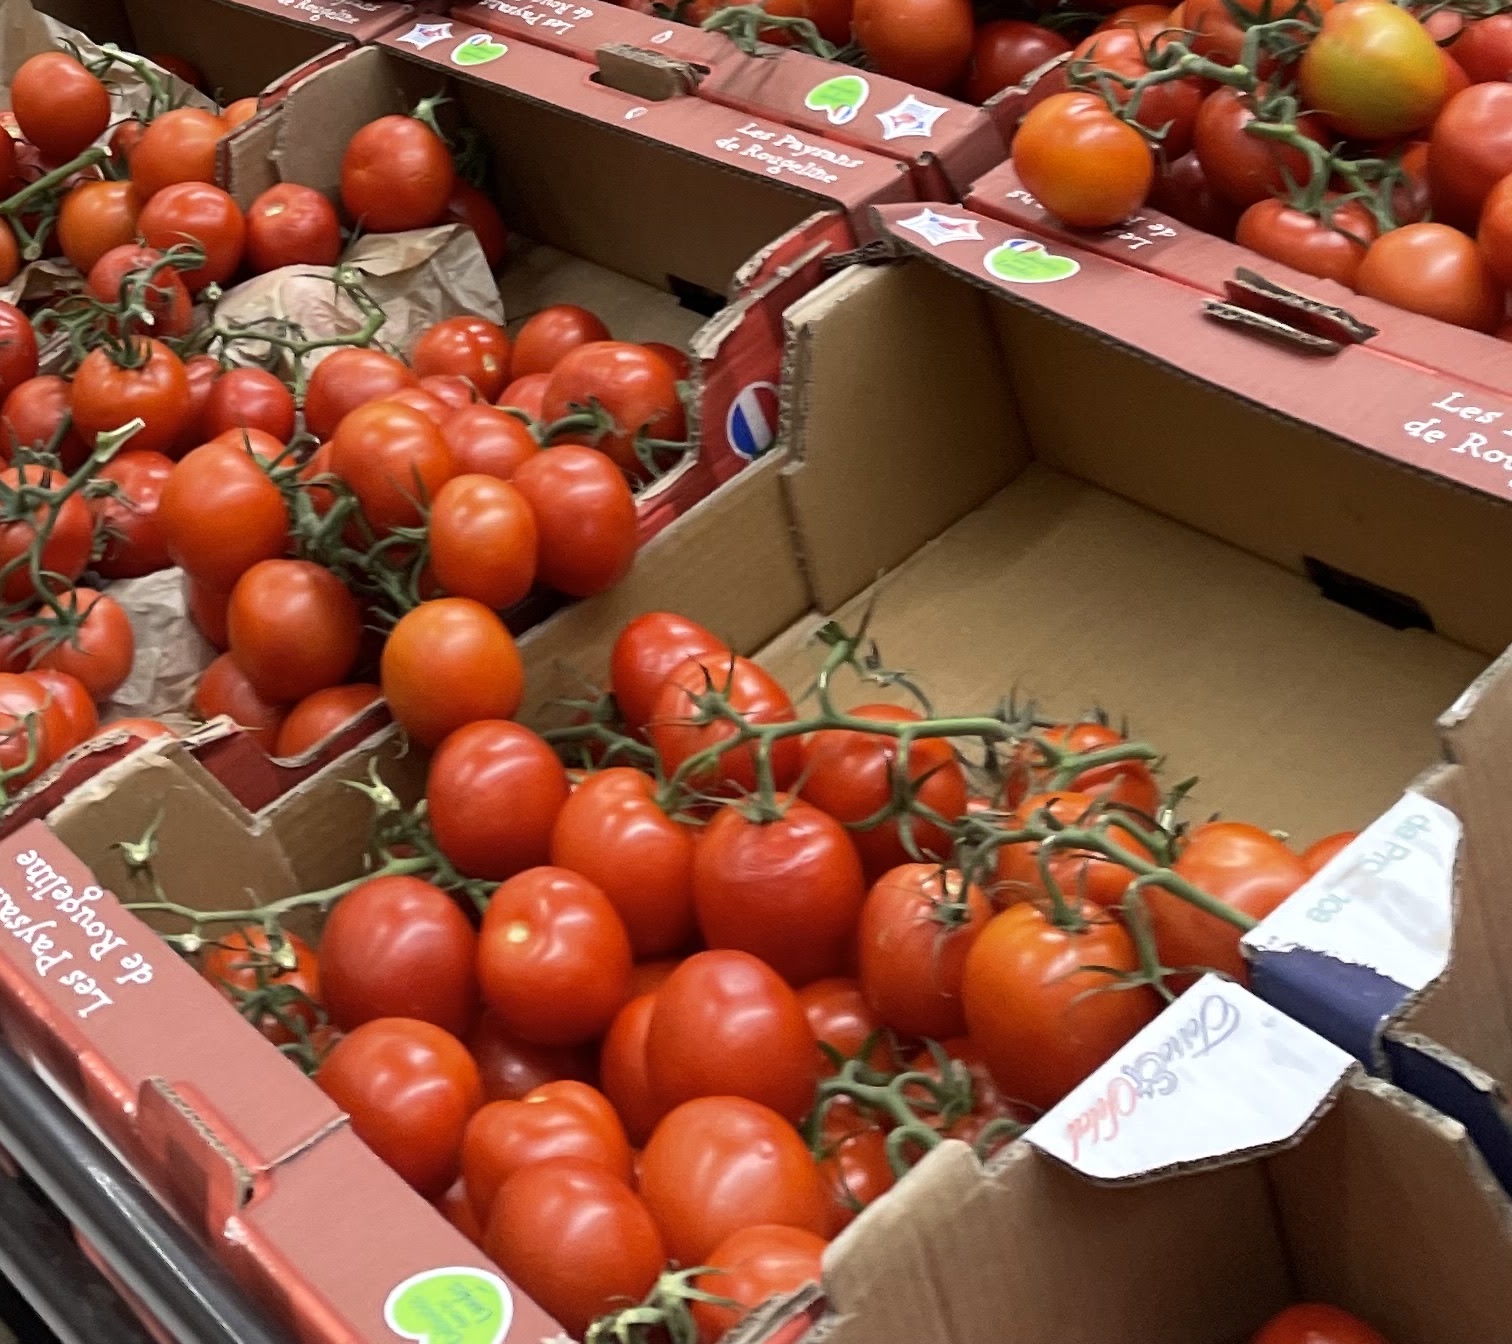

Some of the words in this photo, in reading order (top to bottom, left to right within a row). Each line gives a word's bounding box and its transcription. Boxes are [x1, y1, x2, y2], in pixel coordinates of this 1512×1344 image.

[715, 136, 740, 152] de
[739, 143, 839, 184] Rougeline
[736, 123, 776, 141] Les
[772, 133, 865, 169] Paysans
[1431, 391, 1505, 424] Les
[1403, 418, 1448, 444] de
[15, 848, 128, 962] Rougeline
[114, 953, 154, 985] de
[58, 969, 115, 1019] Les
